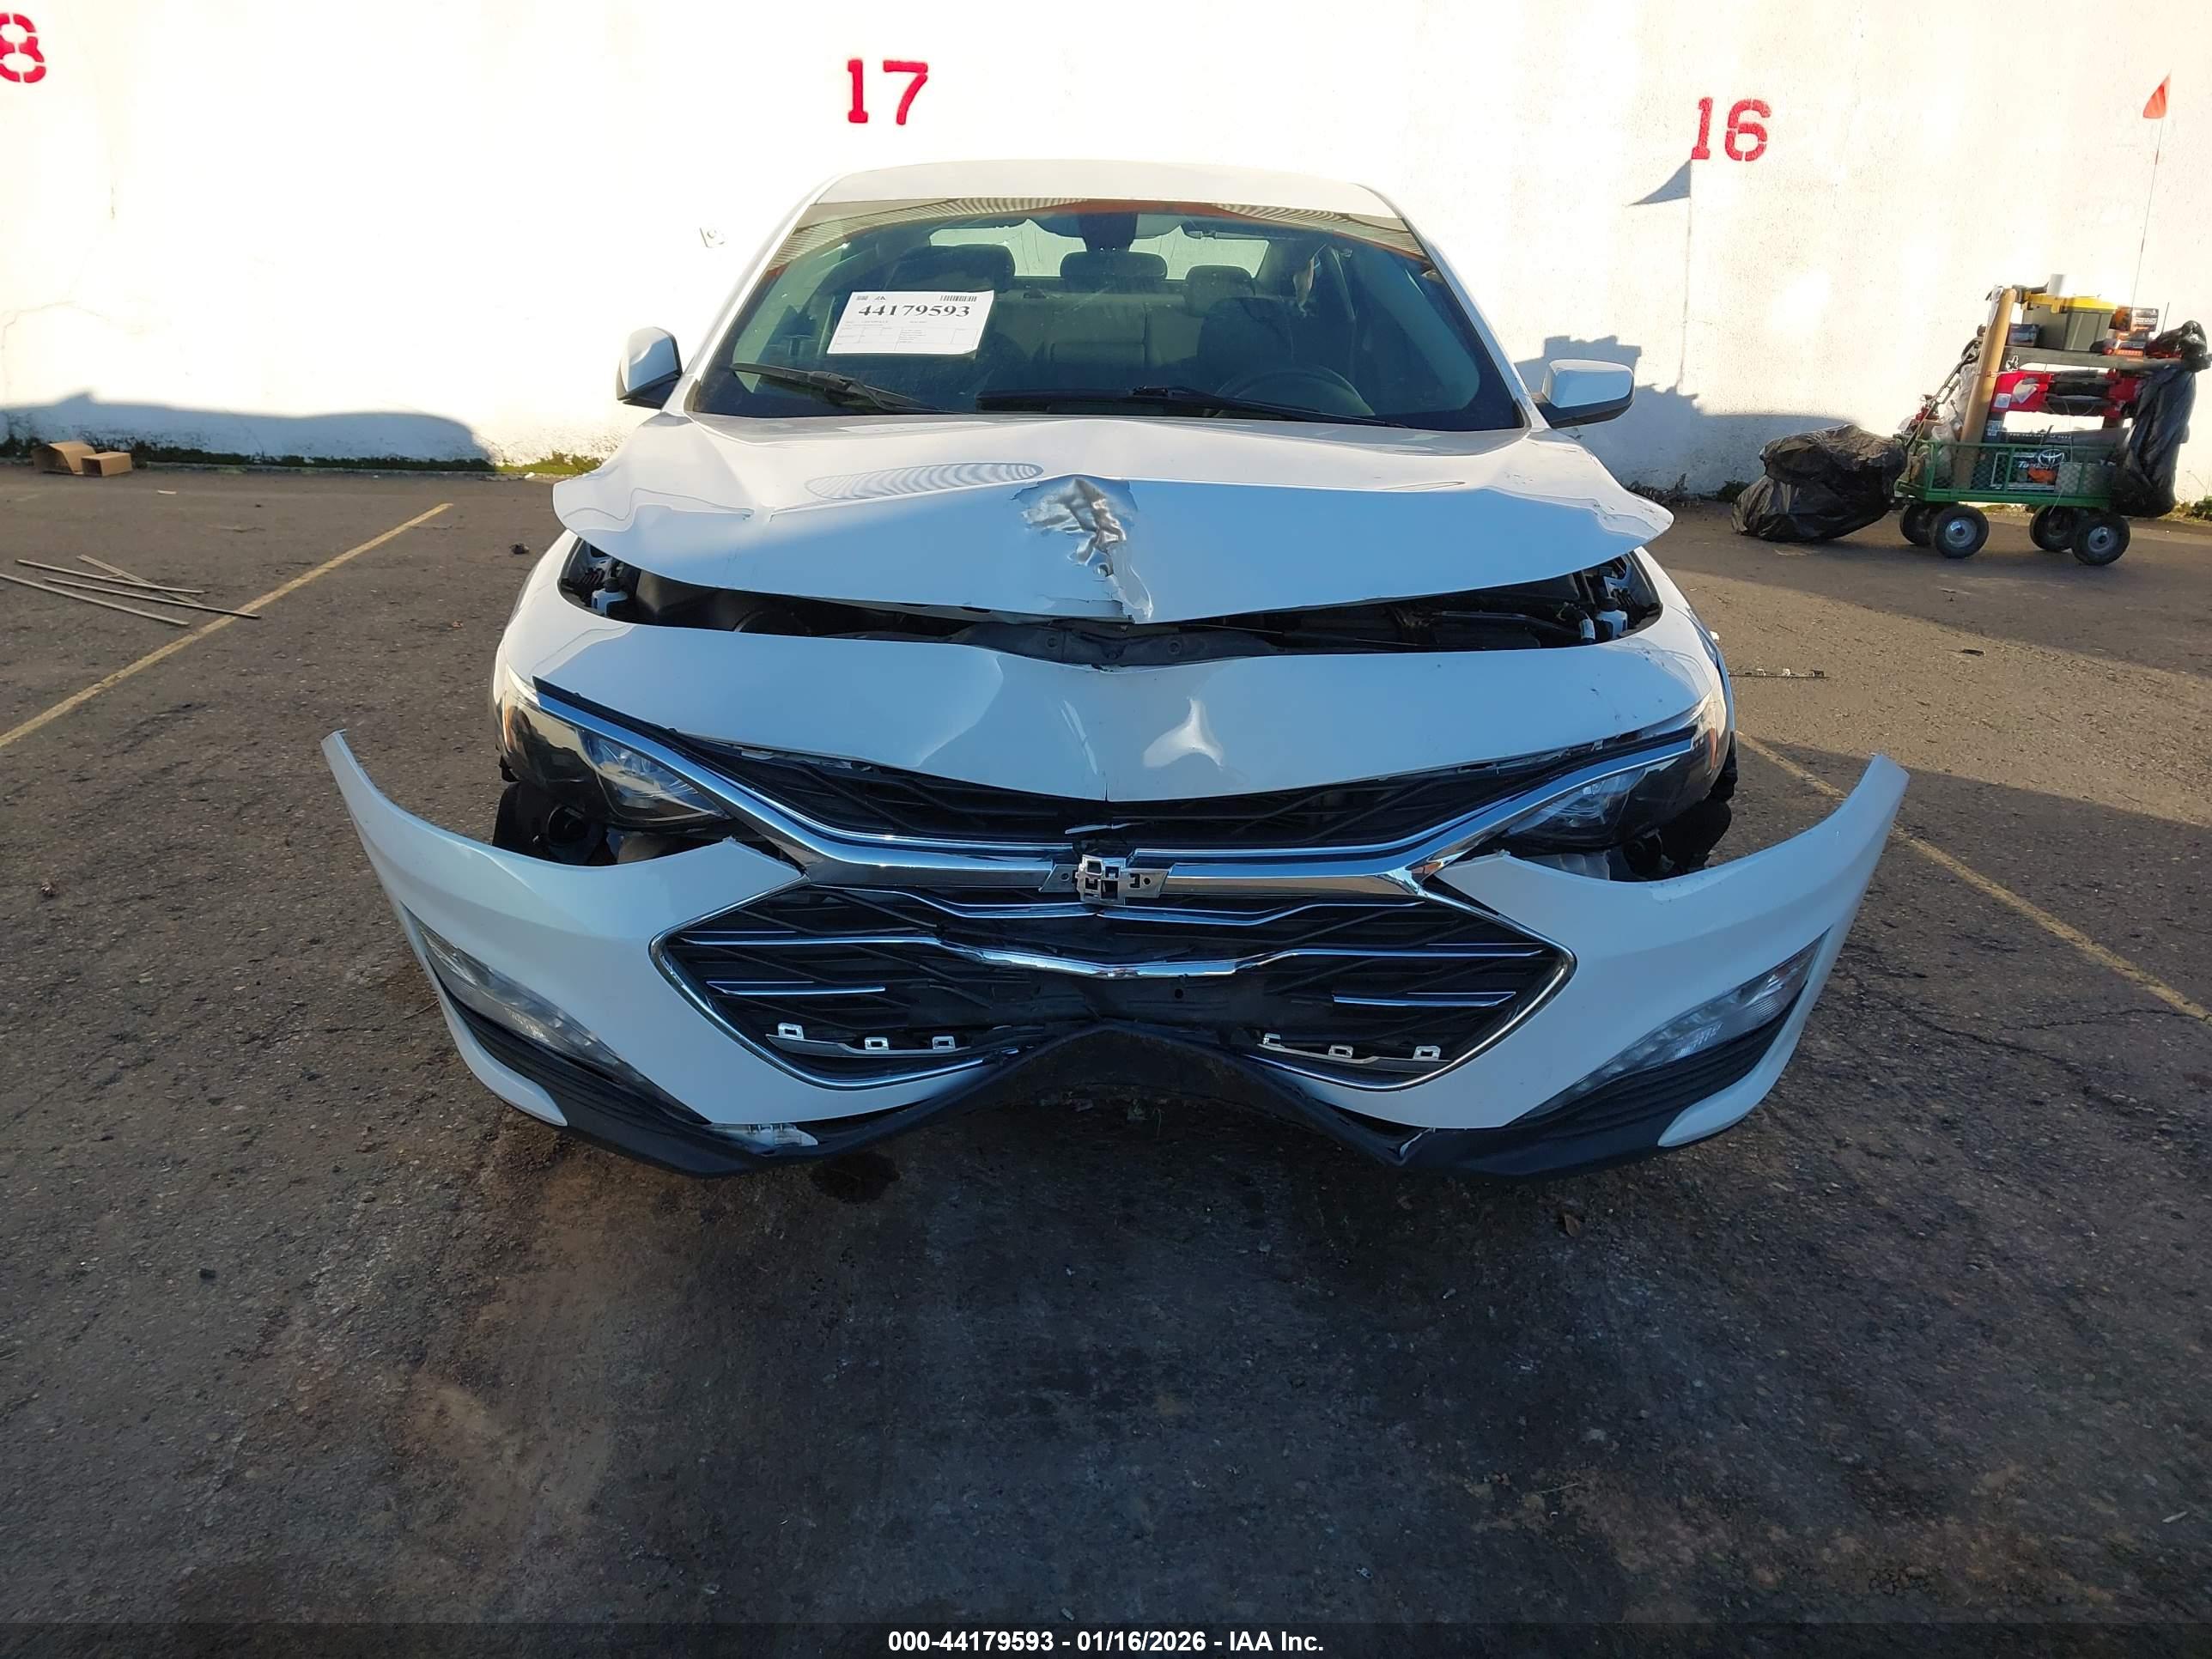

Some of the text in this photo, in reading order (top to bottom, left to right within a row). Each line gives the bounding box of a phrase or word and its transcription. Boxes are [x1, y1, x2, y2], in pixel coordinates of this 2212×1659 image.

[848, 59, 928, 125] 17
[1691, 97, 1771, 161] 16
[859, 305, 970, 318] 44179593
